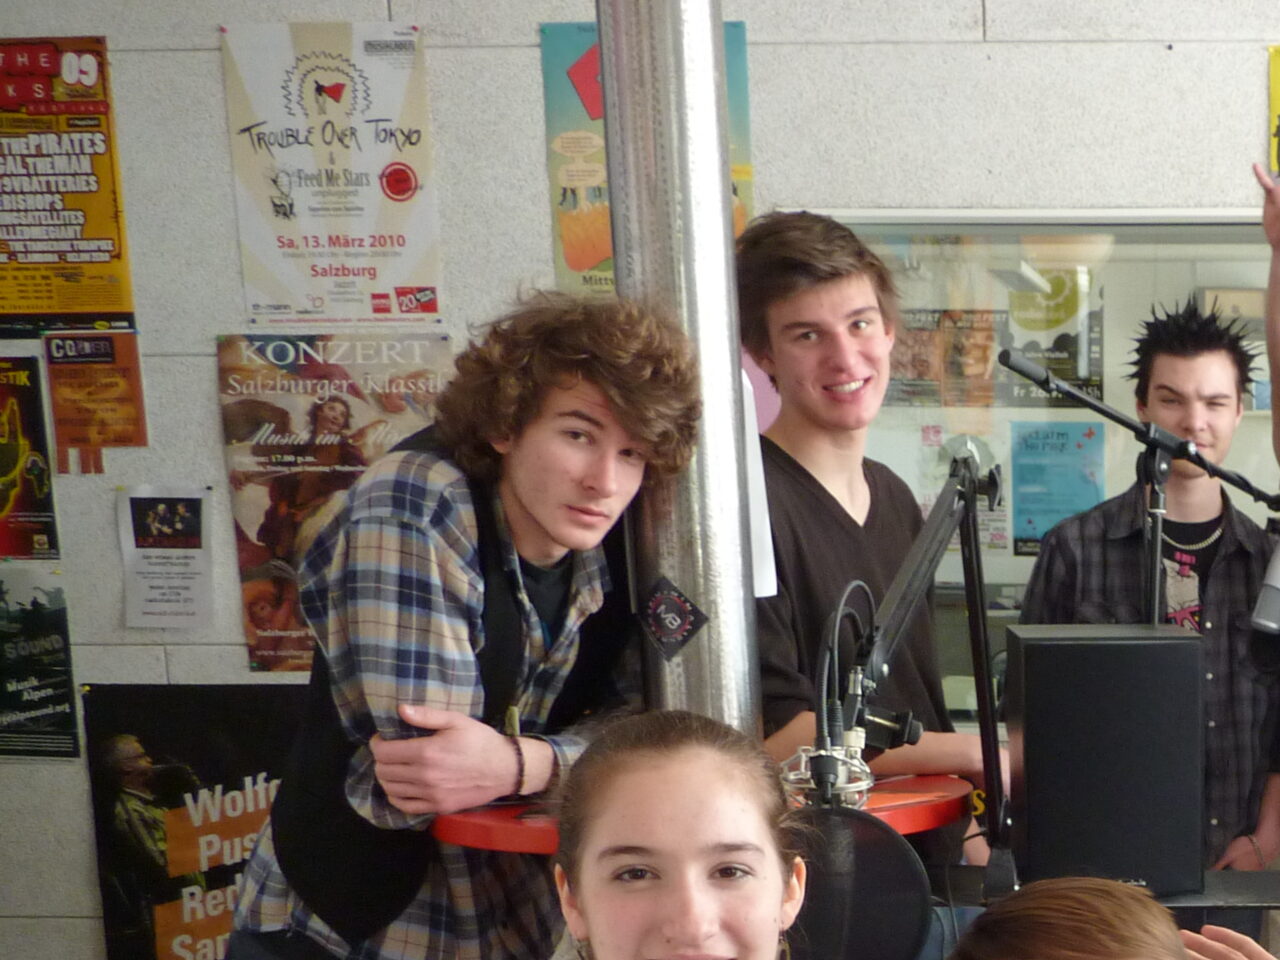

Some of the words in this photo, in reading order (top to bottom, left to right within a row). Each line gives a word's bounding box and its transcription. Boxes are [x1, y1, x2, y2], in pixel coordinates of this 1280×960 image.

[62, 52, 98, 86] 09
[236, 121, 315, 158] TROUBLE
[321, 120, 362, 151] OVER
[364, 118, 421, 152] TOKYO
[303, 236, 325, 249] 13.
[328, 234, 365, 249] März
[369, 235, 406, 248] 2010
[310, 264, 377, 280] Salzburg
[238, 341, 430, 365] KONZERT
[227, 374, 353, 404] Salzburger
